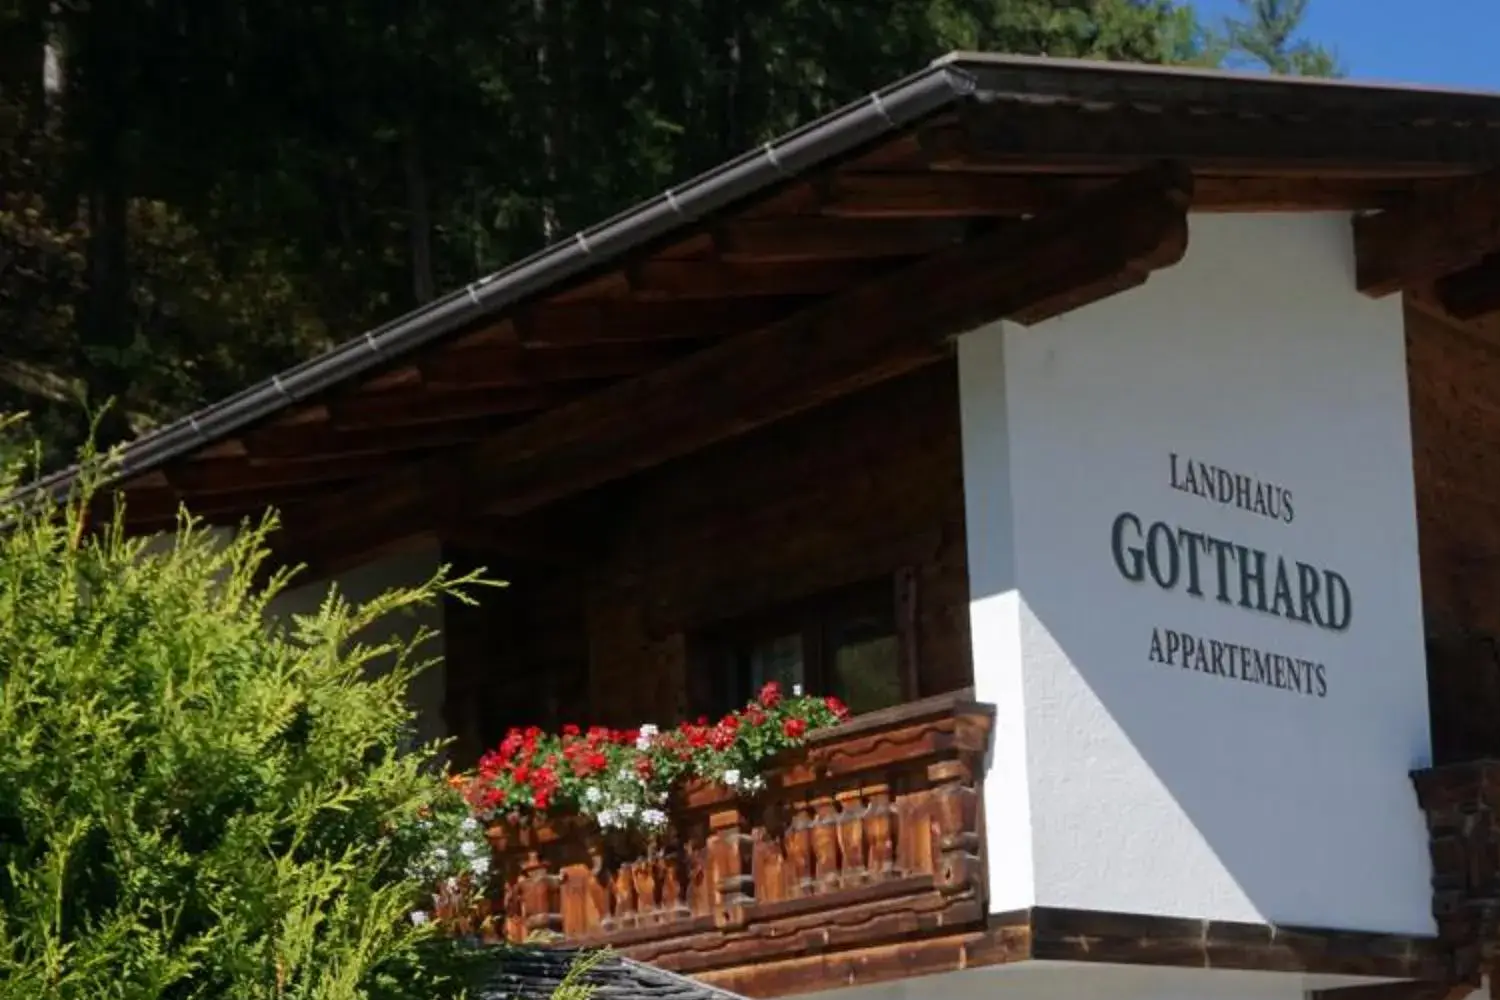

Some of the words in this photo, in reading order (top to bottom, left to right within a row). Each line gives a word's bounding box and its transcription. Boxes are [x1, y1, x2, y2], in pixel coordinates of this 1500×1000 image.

[1169, 453, 1294, 524] LANDHAUS
[1111, 511, 1352, 631] GOTTHARD
[1148, 627, 1328, 698] APPARTEMENTS
